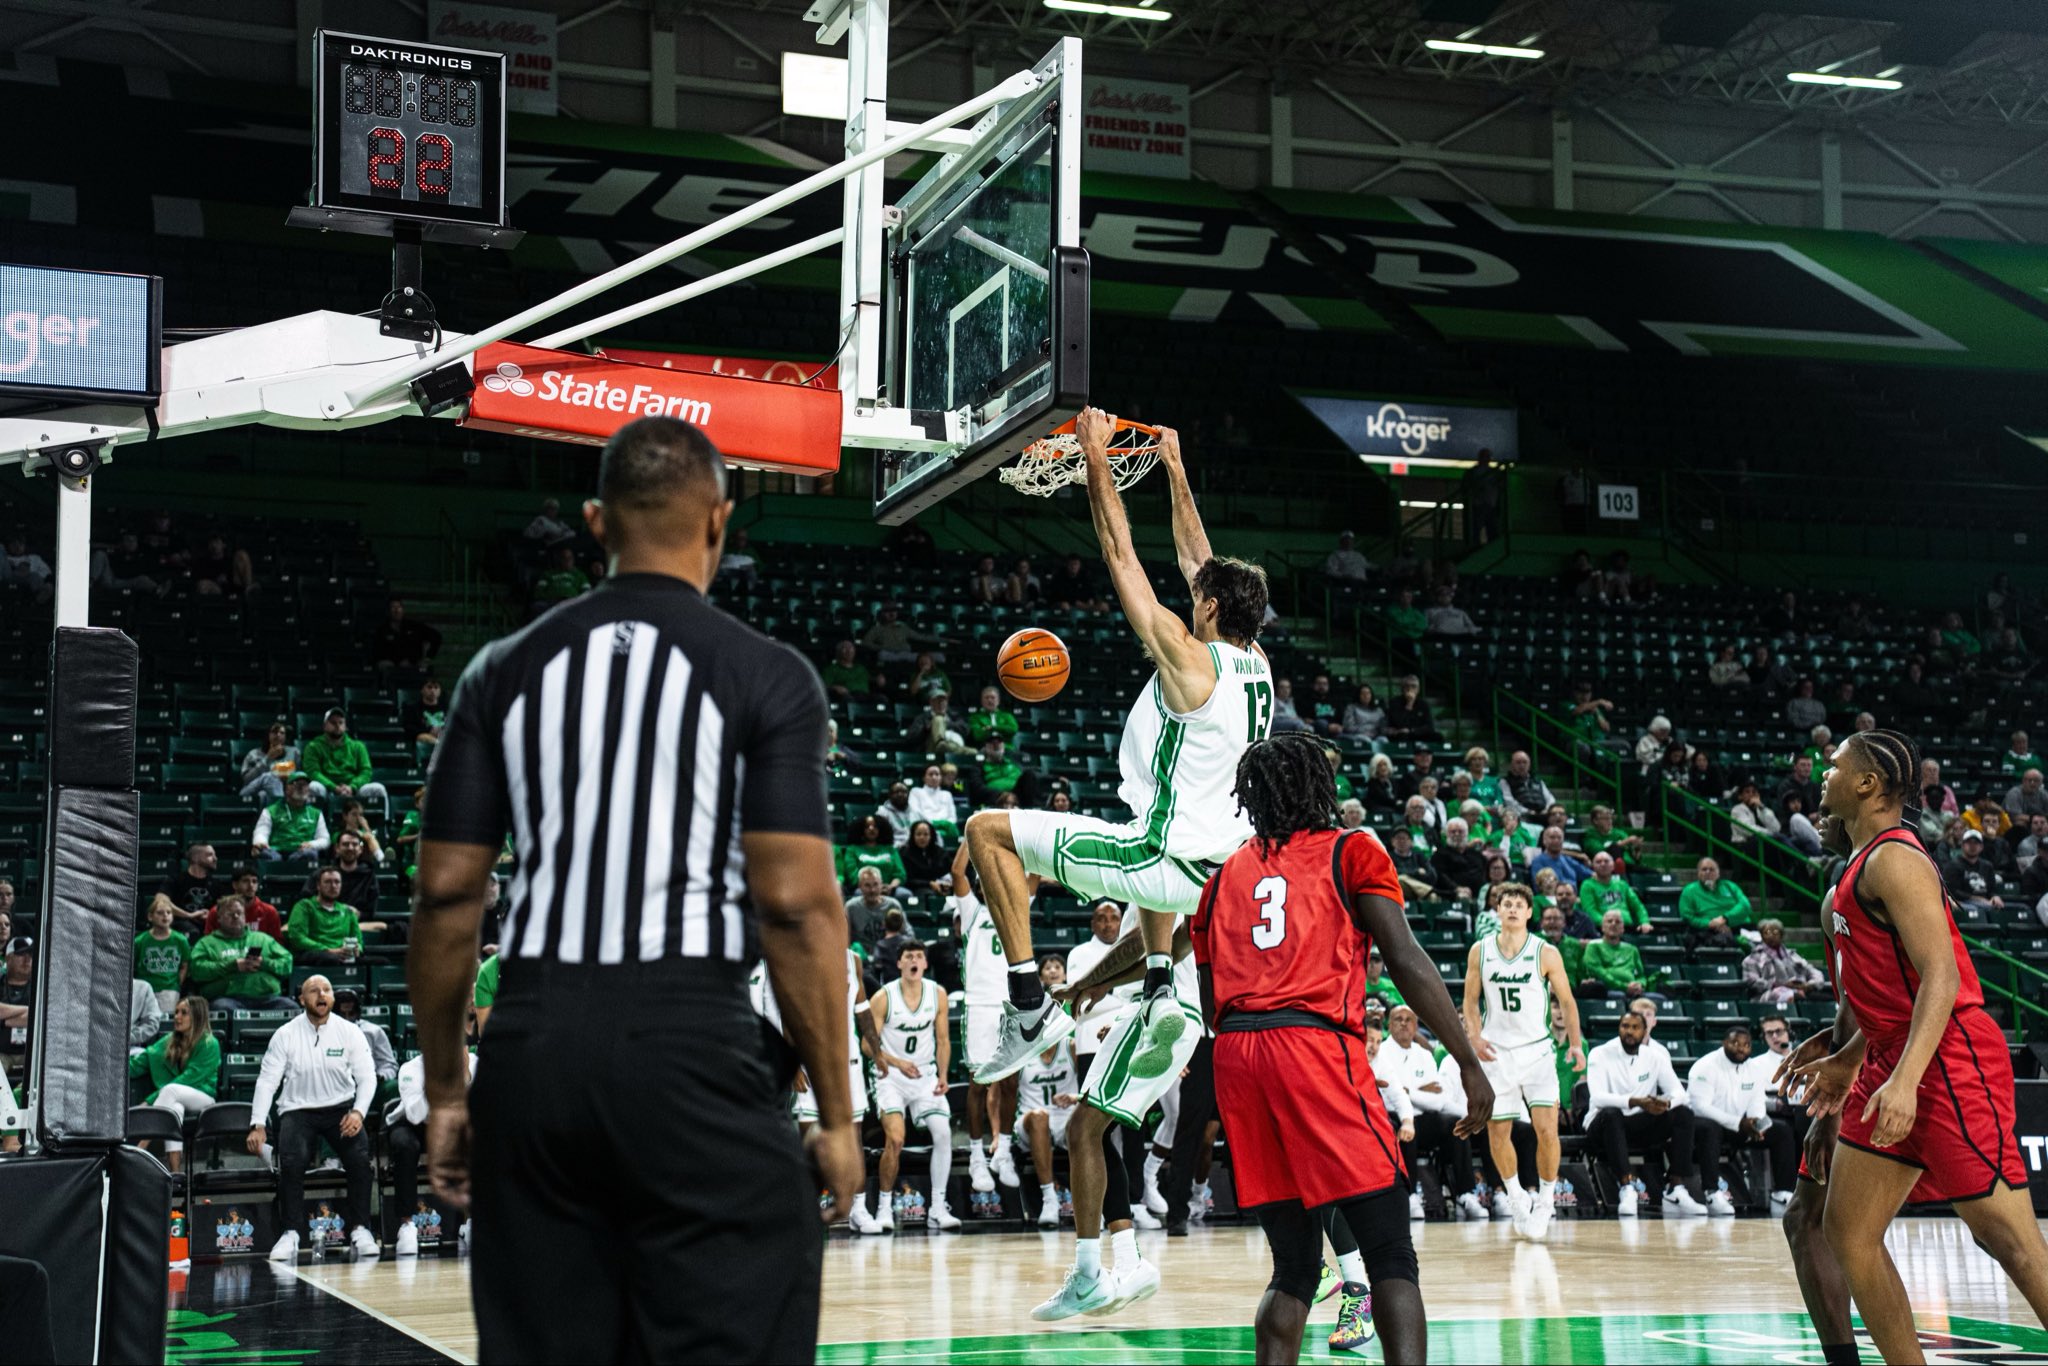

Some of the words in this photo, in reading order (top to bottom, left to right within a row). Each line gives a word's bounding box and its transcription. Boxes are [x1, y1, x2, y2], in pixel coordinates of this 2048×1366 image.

[350, 44, 472, 71] DAKTRONICS
[1085, 114, 1150, 134] FRIENDS
[1154, 121, 1186, 138] AND
[1088, 133, 1142, 152] FAMILY
[1146, 138, 1184, 156] ZONE
[367, 127, 452, 195] 22
[0, 311, 101, 374] ger
[1366, 403, 1451, 456] Kroger
[1604, 492, 1633, 513] 103
[1233, 657, 1252, 676] VAN
[1244, 681, 1271, 743] 13
[1251, 874, 1288, 951] 3
[1499, 987, 1521, 1012] 15
[905, 1036, 917, 1054] 0
[1042, 1084, 1057, 1105] 11
